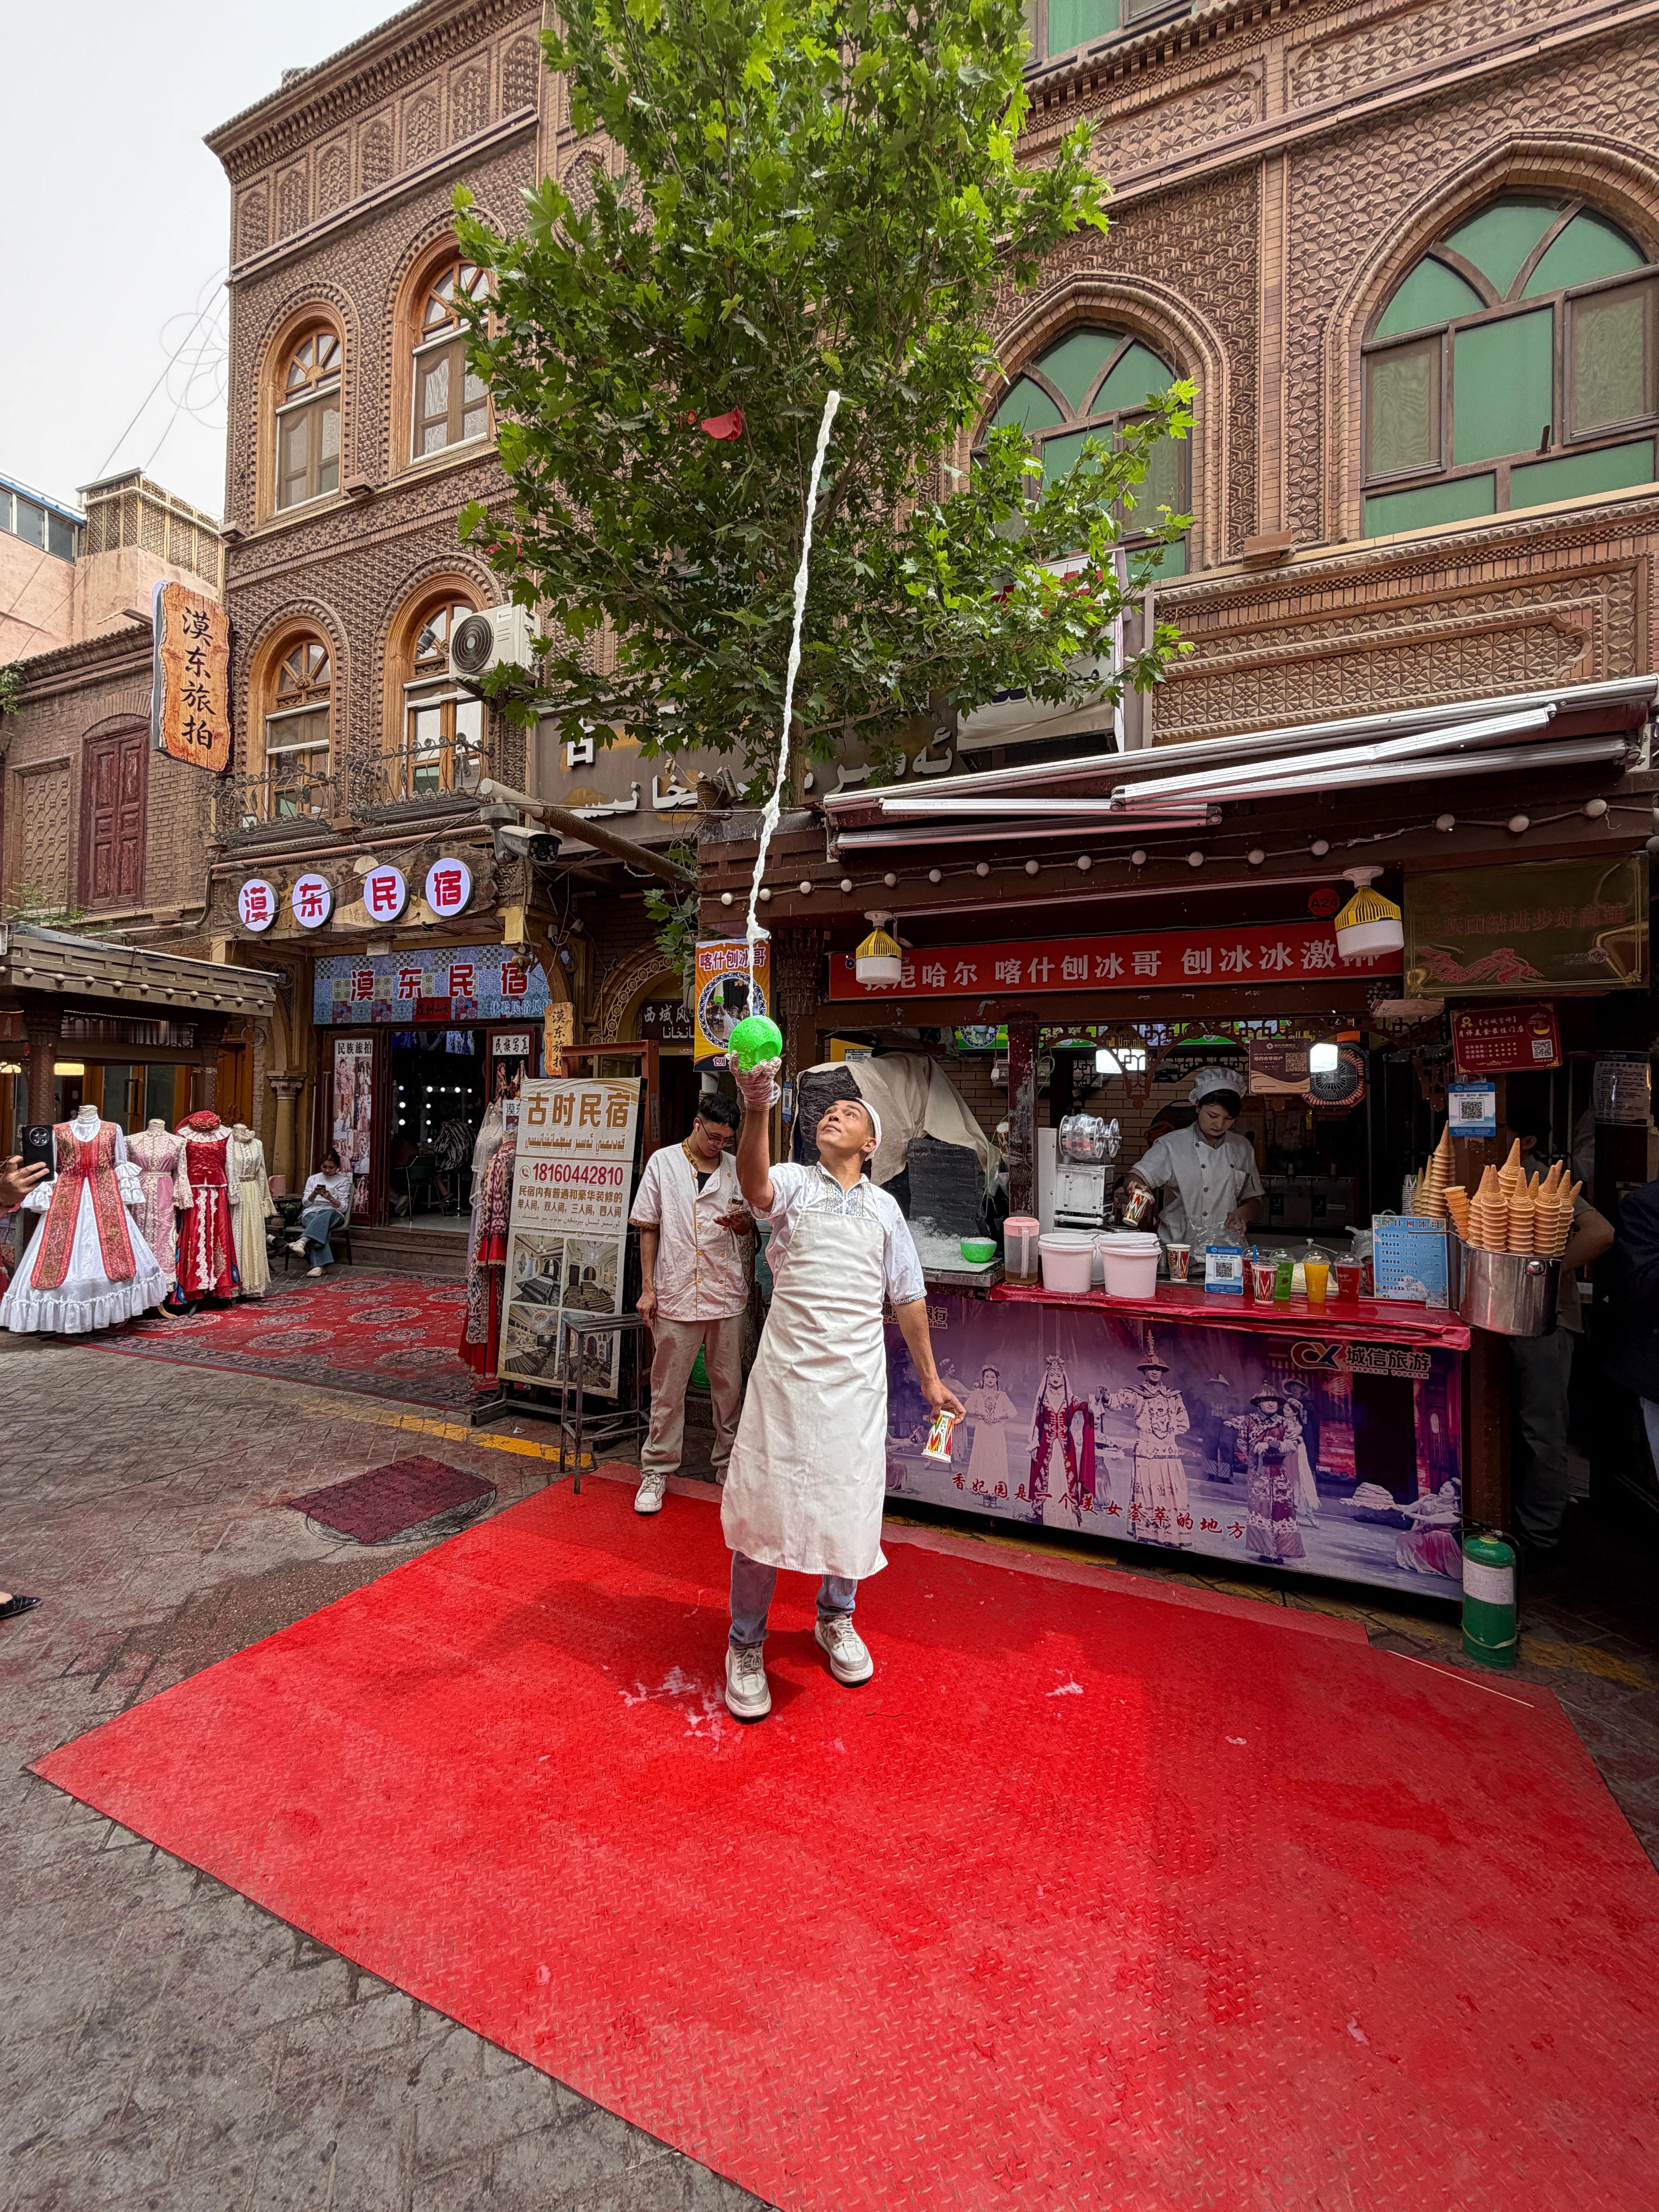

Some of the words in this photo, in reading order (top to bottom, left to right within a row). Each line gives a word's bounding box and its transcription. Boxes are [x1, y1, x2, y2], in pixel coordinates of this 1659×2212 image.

[180, 606, 217, 750] 漠东旅拍
[243, 869, 462, 923] 漠东民宿
[1310, 897, 1339, 908] A24
[1422, 902, 1626, 936] 民族团结进步好商铺
[350, 962, 529, 1002] 漠东民宿
[865, 960, 977, 991] 尼哈尔
[995, 949, 1162, 984] 喀什刨冰哥
[1181, 939, 1380, 975] 刨冰冰激
[338, 1041, 372, 1055] 民族旅拍
[495, 1037, 529, 1054] 民族写真
[527, 1092, 632, 1129] 古时民宿
[532, 1163, 623, 1187] 18160442810
[519, 1185, 623, 1203] 民宿内有普通和豪华装修的
[1346, 1346, 1431, 1372] 城信旅游
[951, 1472, 1246, 1539] 香妃园是一个美女荟萃的地方
